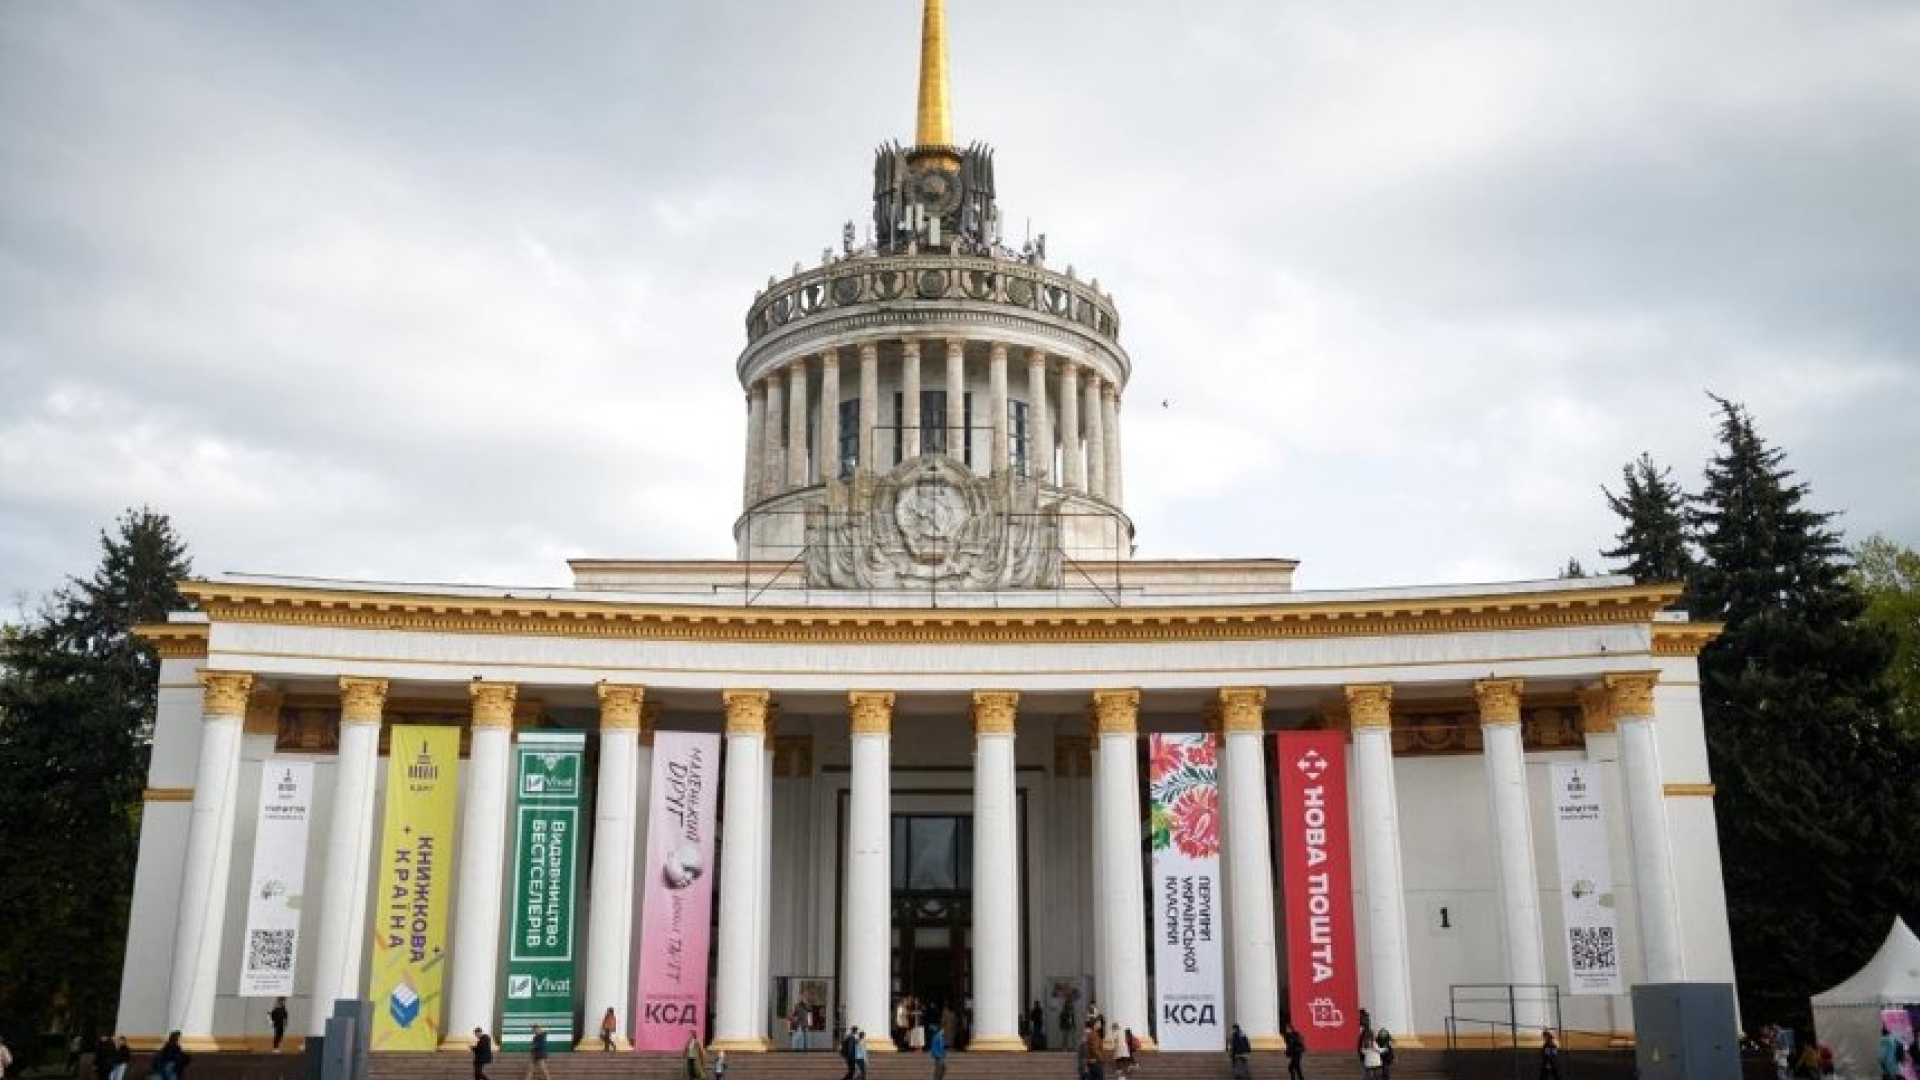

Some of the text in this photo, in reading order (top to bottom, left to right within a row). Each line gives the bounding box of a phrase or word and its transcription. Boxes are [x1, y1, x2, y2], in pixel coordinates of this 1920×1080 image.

[665, 761, 688, 828] ДРУГ
[387, 849, 411, 949] КРАЇНА
[409, 836, 434, 964] КНИЖКОВА
[1165, 875, 1180, 946] КЛАСИКИ
[1199, 875, 1211, 942] ПЕРЛИНИ
[1304, 786, 1334, 984] НОВА ПОШТА
[1440, 907, 1452, 929] 1
[1182, 875, 1199, 974] УКРАЇНСЬКОЇ
[535, 976, 570, 991] Vivat
[644, 1002, 697, 1026] КСД
[1163, 1003, 1217, 1026] КСД
